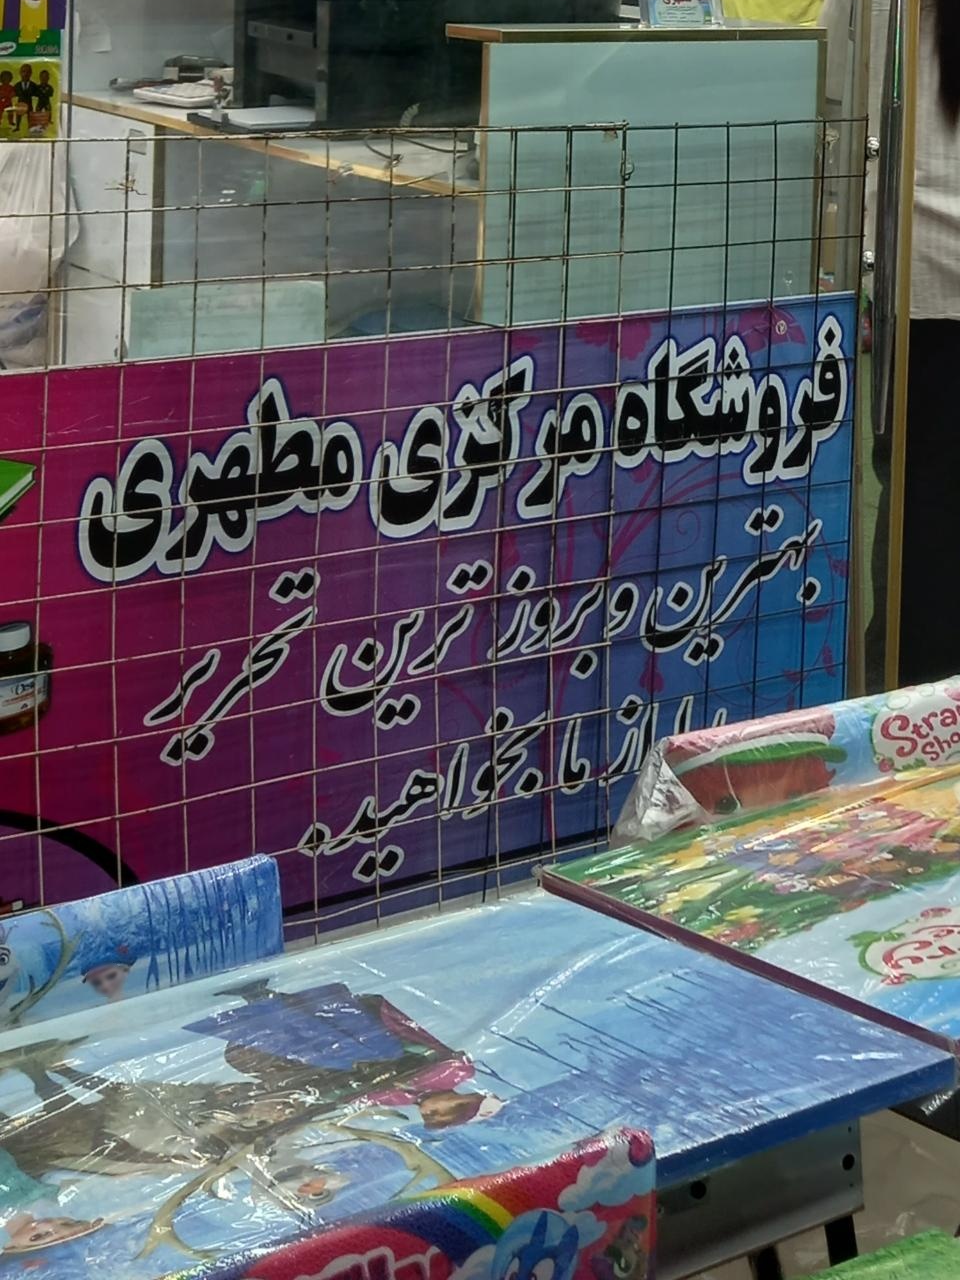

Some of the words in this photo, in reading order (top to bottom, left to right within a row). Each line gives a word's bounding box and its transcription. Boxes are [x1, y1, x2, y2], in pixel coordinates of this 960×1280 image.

[80, 376, 363, 580] مطهری
[614, 315, 846, 485] فروشگاه
[143, 567, 320, 765] تحریر
[641, 501, 825, 666] بهترین
